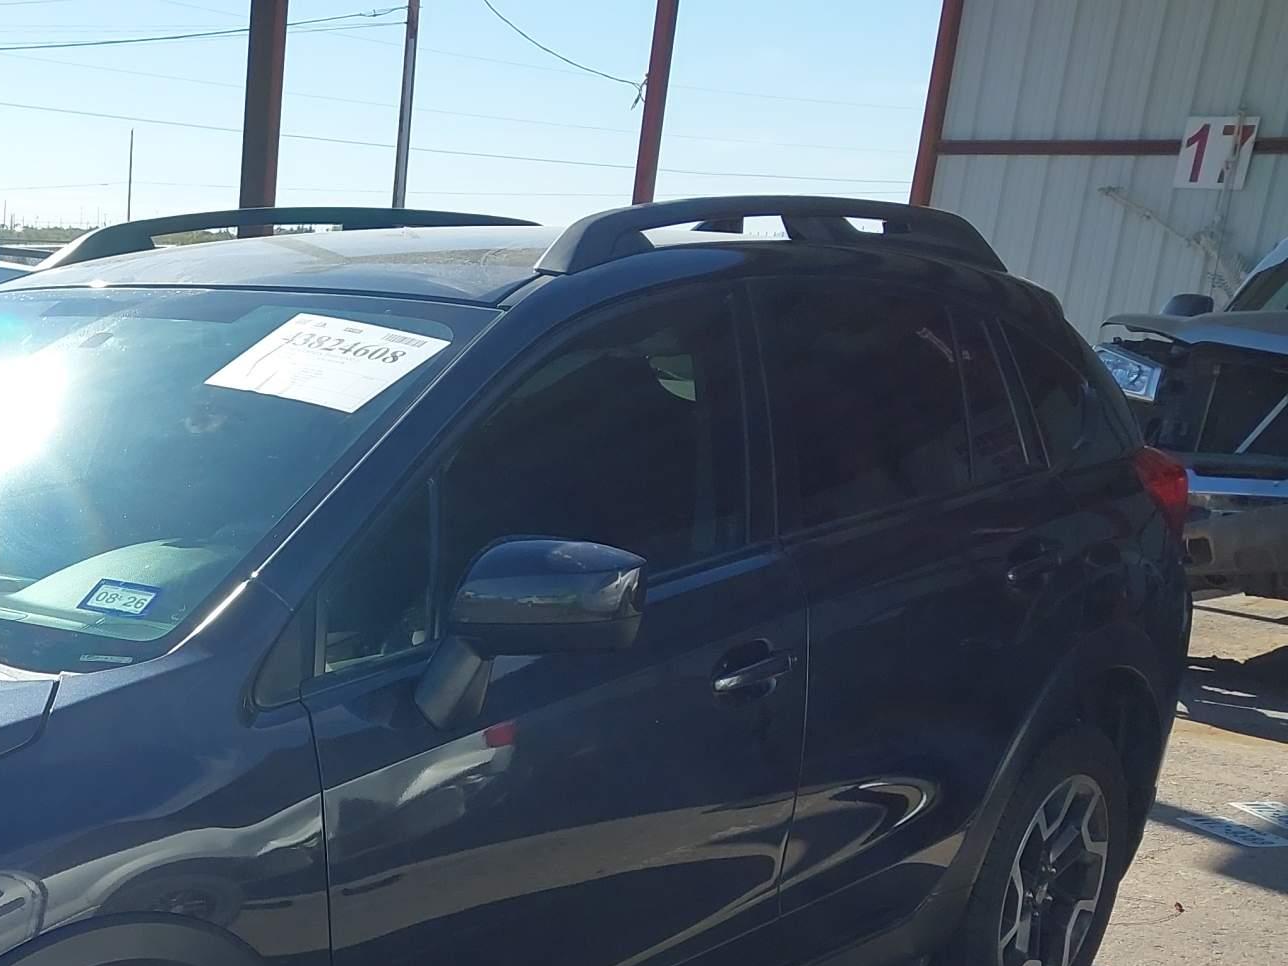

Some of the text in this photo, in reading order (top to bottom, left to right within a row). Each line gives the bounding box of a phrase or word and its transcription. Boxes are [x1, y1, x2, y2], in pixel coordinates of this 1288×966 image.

[1186, 123, 1256, 183] 17
[281, 331, 407, 364] 43824608
[95, 591, 148, 609] 08 26
